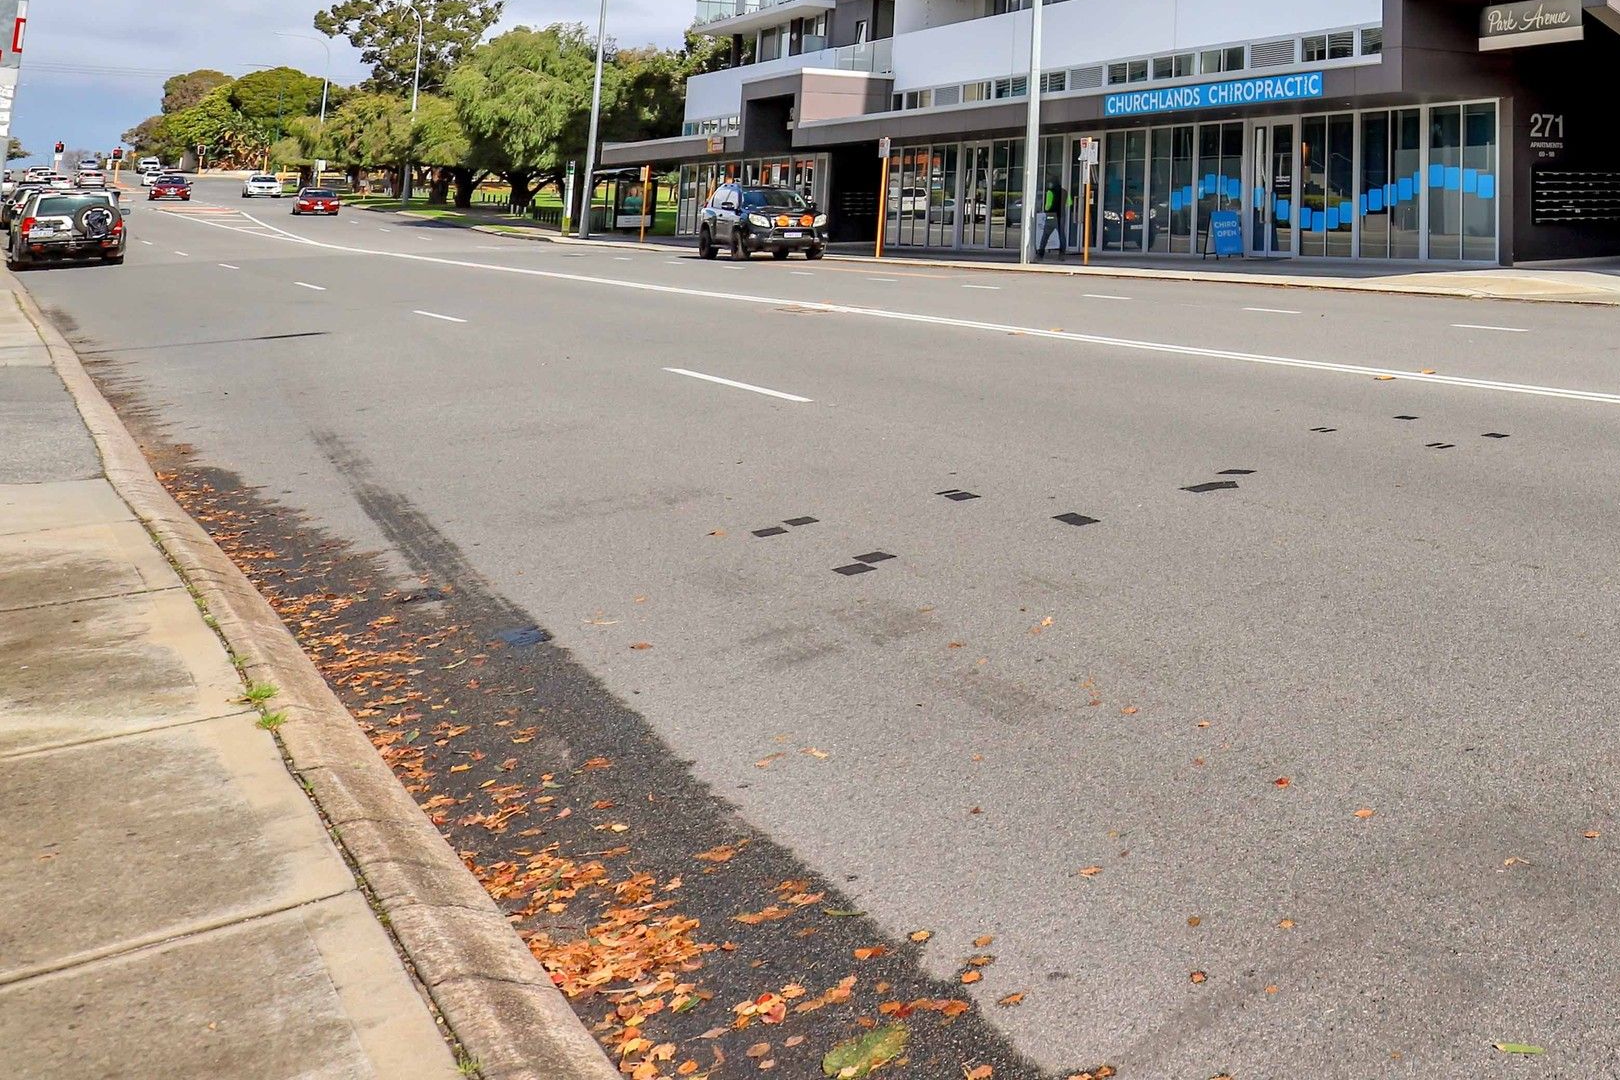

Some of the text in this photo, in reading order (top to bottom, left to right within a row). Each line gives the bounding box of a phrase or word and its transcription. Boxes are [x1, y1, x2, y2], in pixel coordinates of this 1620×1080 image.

[1488, 3, 1571, 34] Park Avenue
[1107, 74, 1320, 114] CHURCHLANDS CHIROPRACTIC
[1530, 113, 1564, 138] 271
[1530, 141, 1564, 149] APARTMENTS
[1214, 220, 1237, 228] CHIRO
